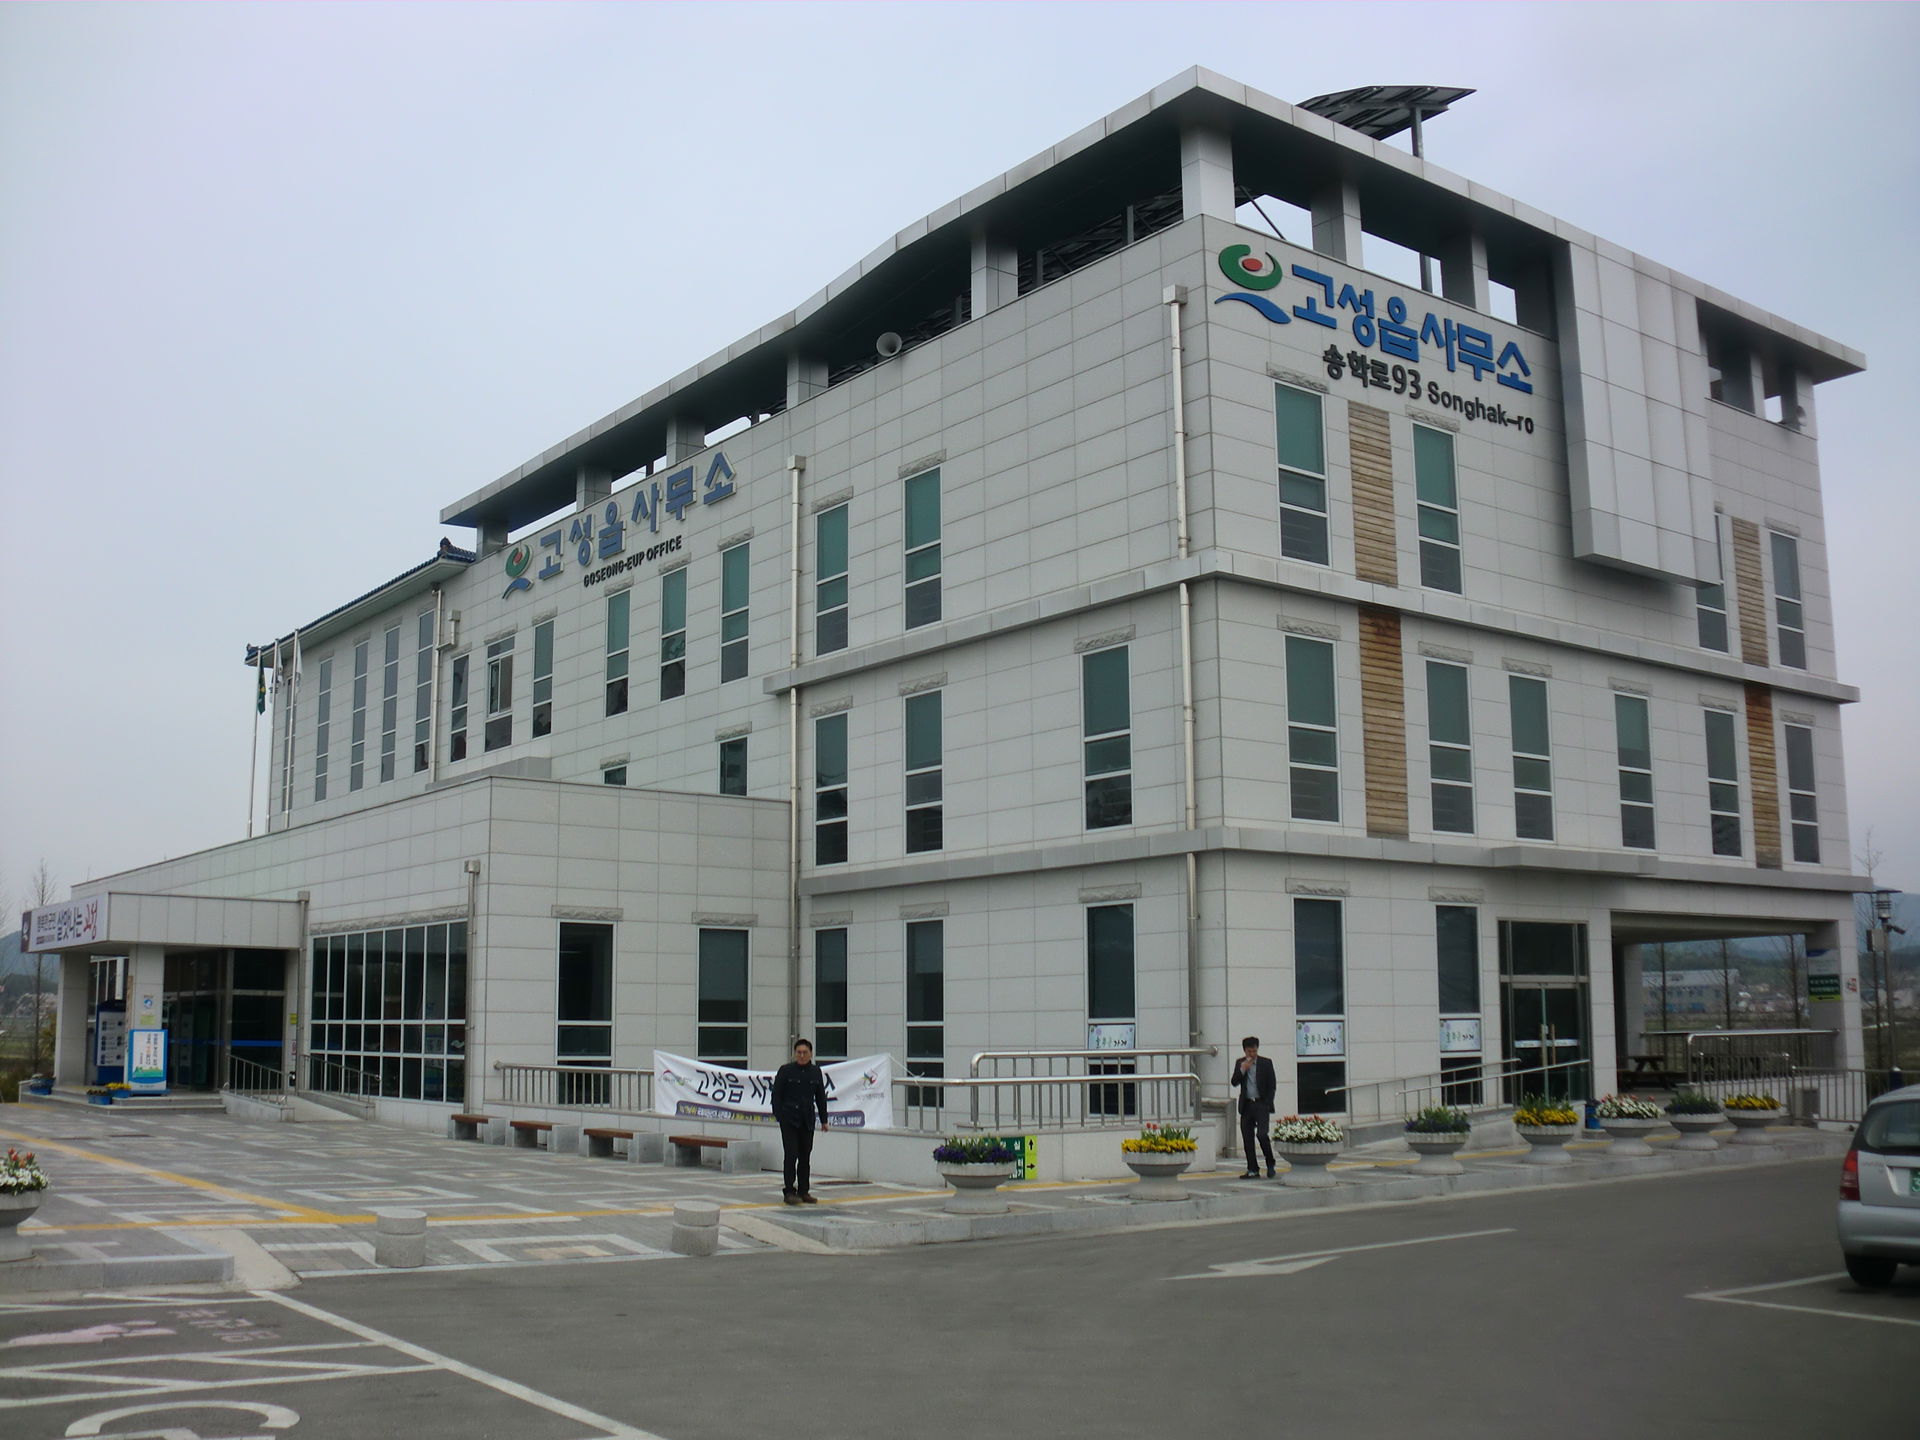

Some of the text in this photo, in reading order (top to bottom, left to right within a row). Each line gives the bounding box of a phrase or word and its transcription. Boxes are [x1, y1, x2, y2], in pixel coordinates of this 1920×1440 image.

[1292, 263, 1534, 395] 고성읍사무소
[1427, 381, 1534, 434] Songhak-ro
[538, 451, 737, 581] 고성읍사무소
[583, 535, 683, 588] GOSEONG-EUP OFFICE
[696, 1069, 744, 1103] 고성읍
